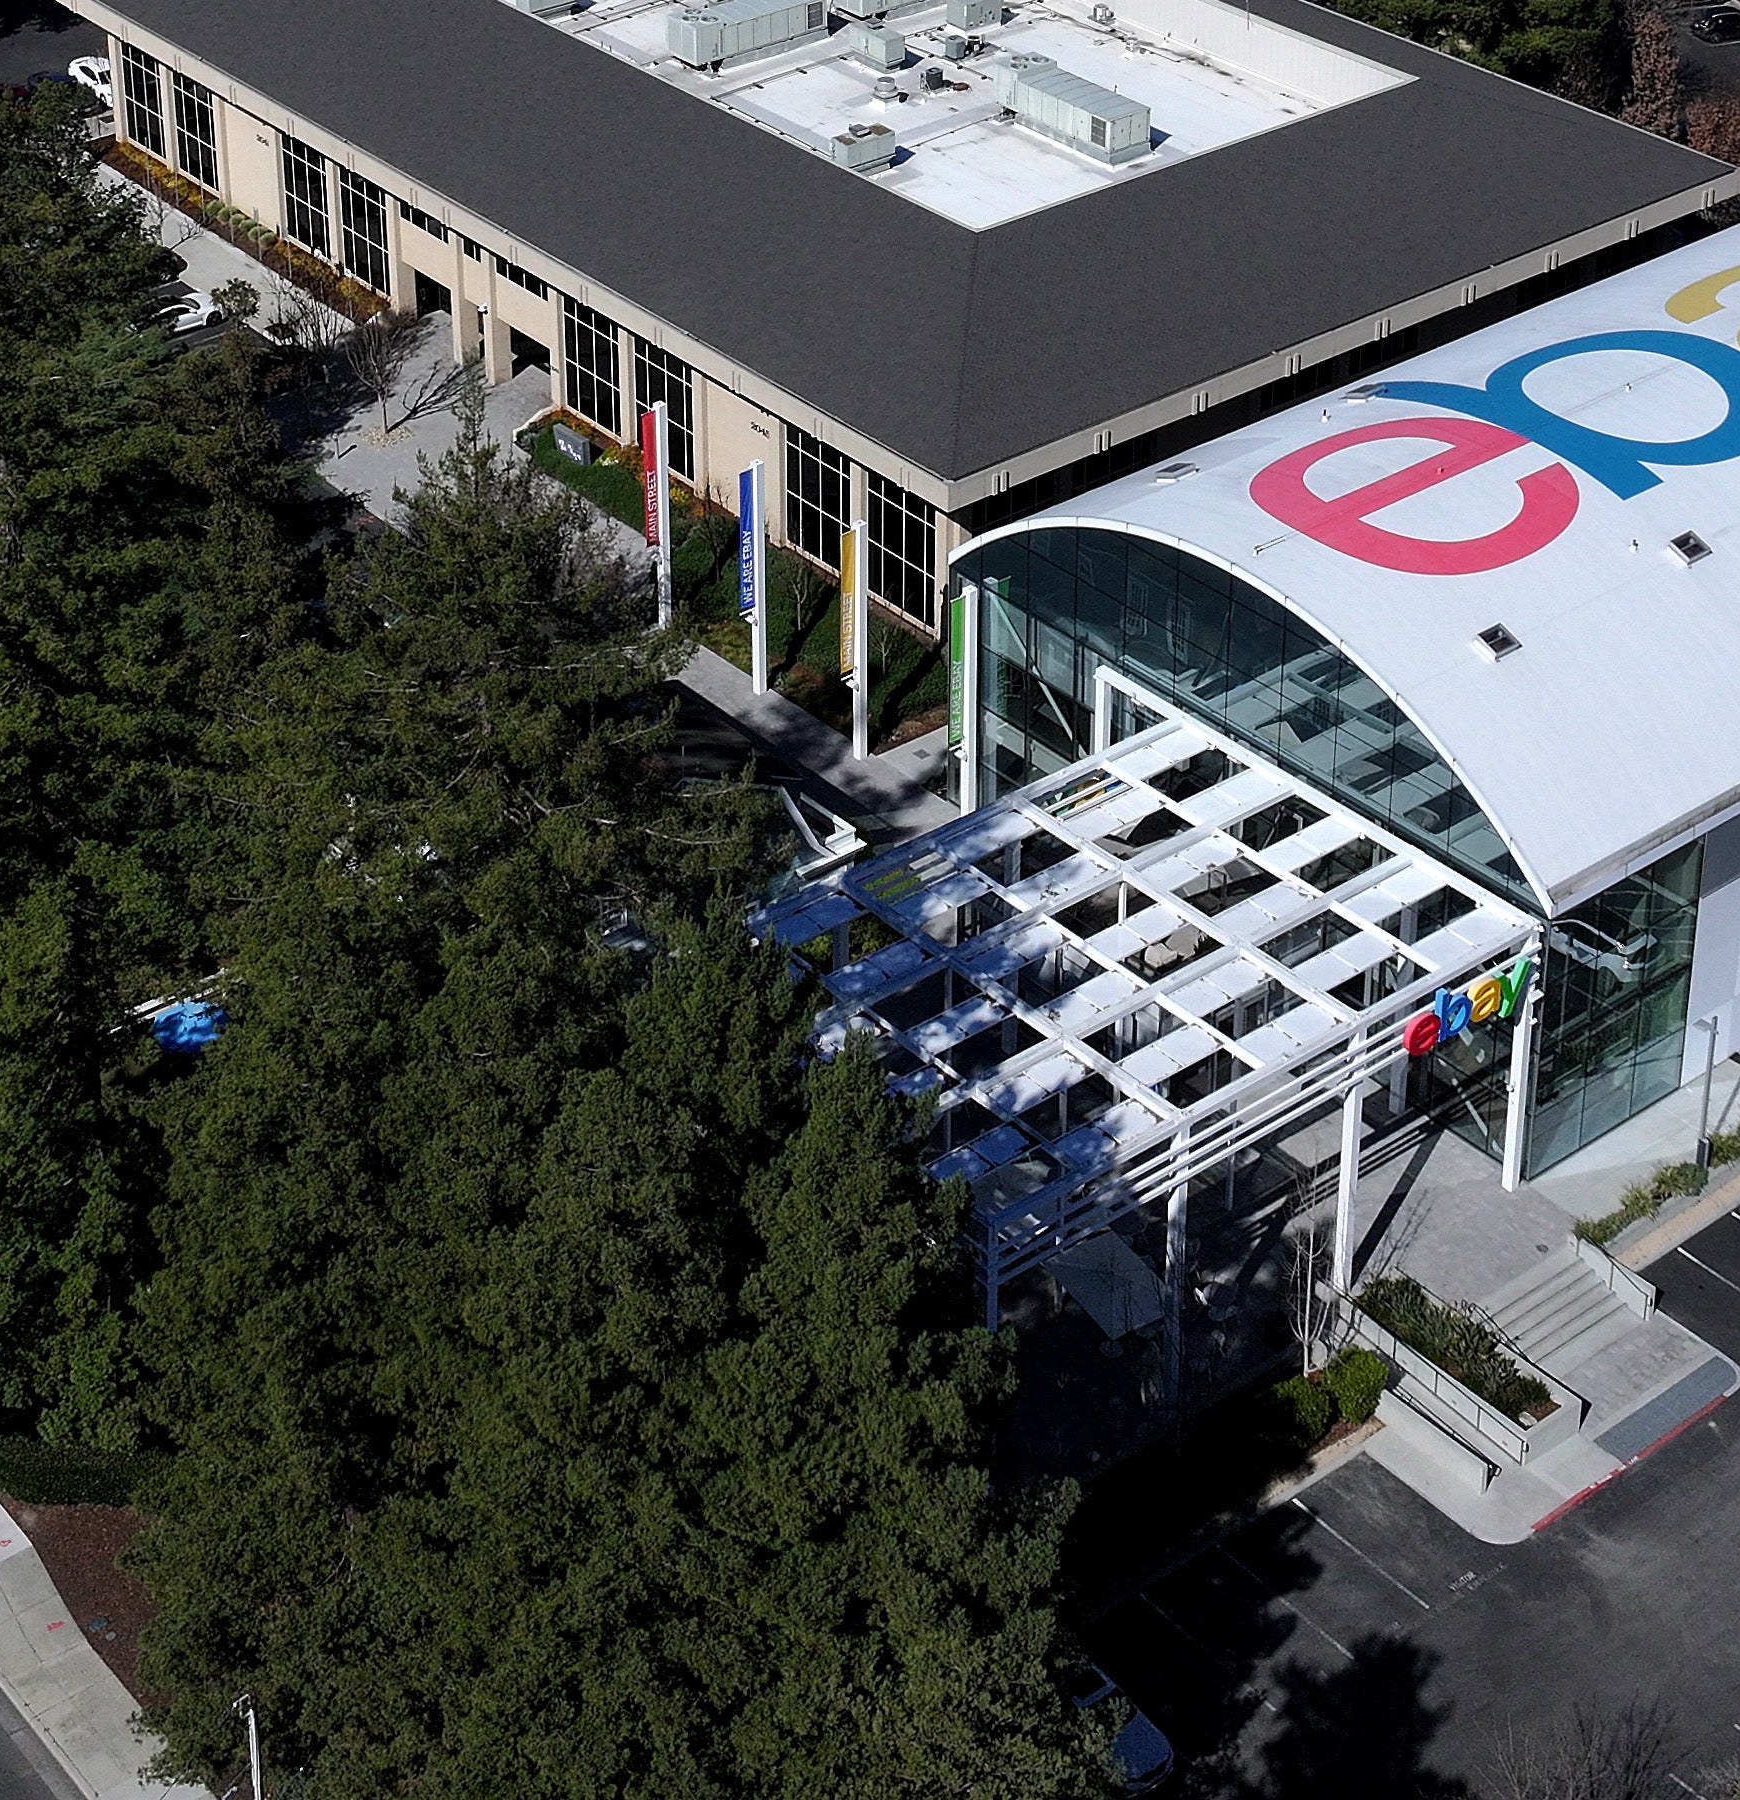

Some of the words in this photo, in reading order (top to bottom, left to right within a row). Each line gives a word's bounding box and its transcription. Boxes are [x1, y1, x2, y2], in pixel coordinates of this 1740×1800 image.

[646, 470, 657, 511] STREET
[647, 512, 658, 542] MAIN
[742, 530, 753, 560] EBAY
[742, 560, 753, 583] ARE
[743, 584, 753, 604] WE
[842, 591, 853, 633] STREET
[842, 635, 853, 668] MAIN
[951, 660, 962, 690] EBAY
[951, 691, 962, 714] ARE
[951, 715, 961, 738] WE
[1402, 955, 1532, 1057] ebay
